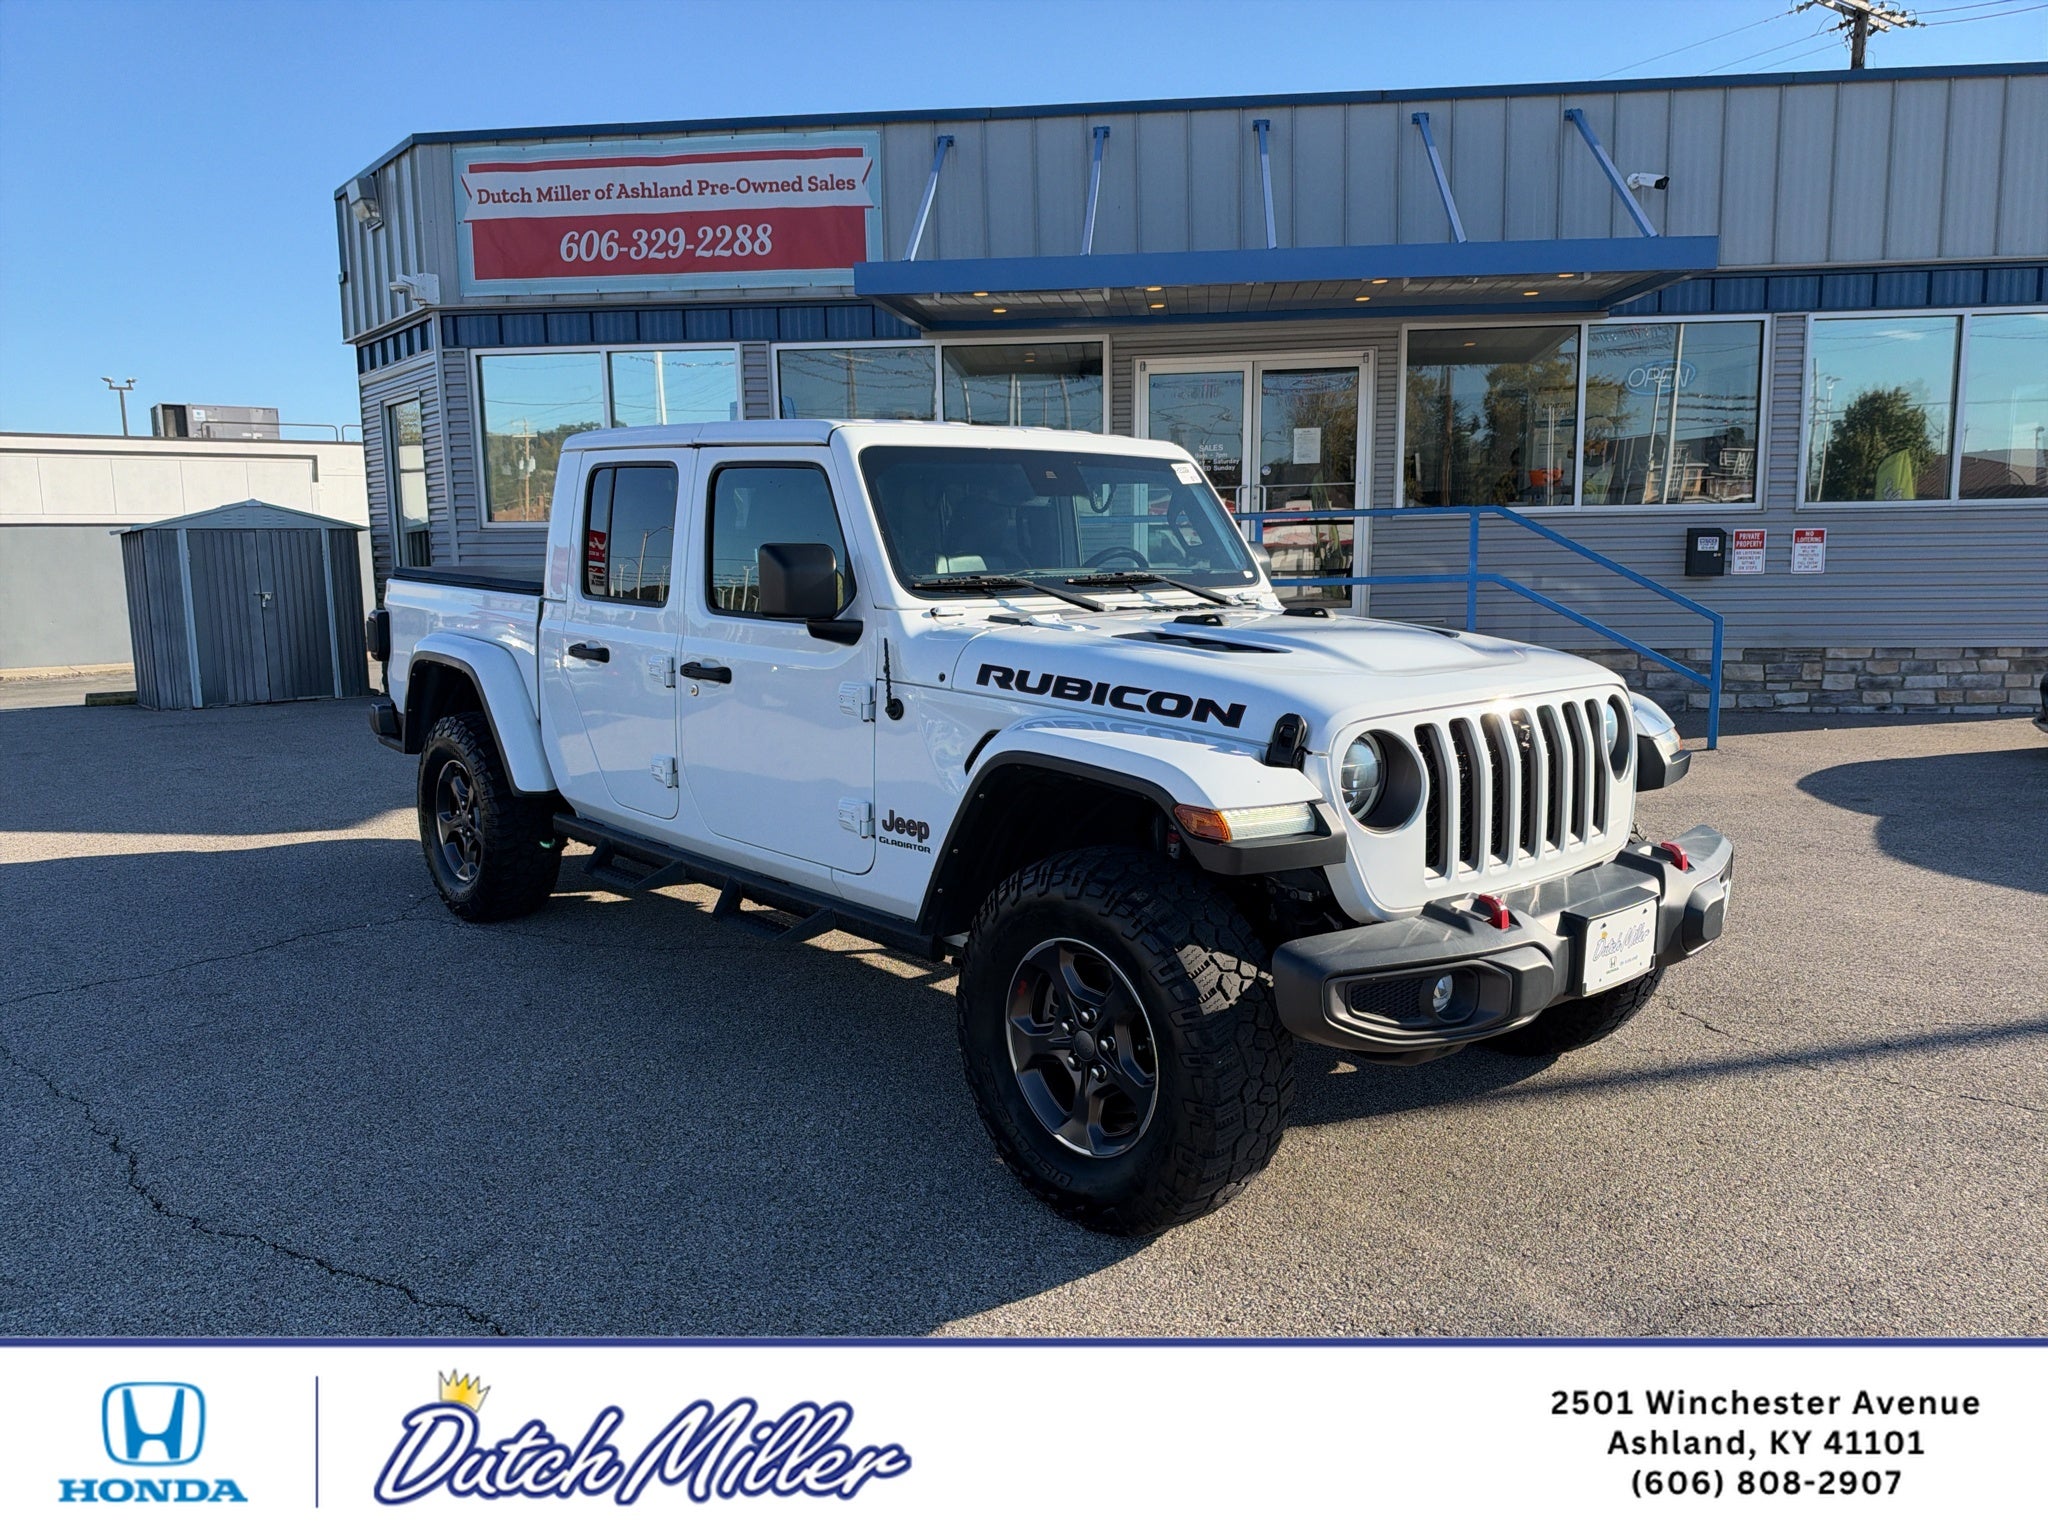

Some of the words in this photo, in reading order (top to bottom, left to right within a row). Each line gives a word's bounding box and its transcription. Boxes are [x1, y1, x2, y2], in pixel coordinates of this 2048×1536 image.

[477, 186, 532, 204] Dutch
[536, 181, 591, 203] Miller
[595, 183, 615, 200] of
[616, 179, 694, 199] Ashland
[697, 176, 803, 196] Pre-Owned
[808, 173, 857, 192] Sales
[560, 223, 773, 263] 606-329-2288
[1628, 367, 1690, 388] OPEN
[1736, 540, 1763, 548] PROPERTY
[1739, 532, 1760, 540] PRIVATE
[976, 663, 1247, 729] RUBICON
[881, 809, 930, 843] Jeep
[878, 836, 931, 855] GLADIATOR
[1592, 931, 1625, 962] Dutch
[1624, 921, 1651, 950] Miller
